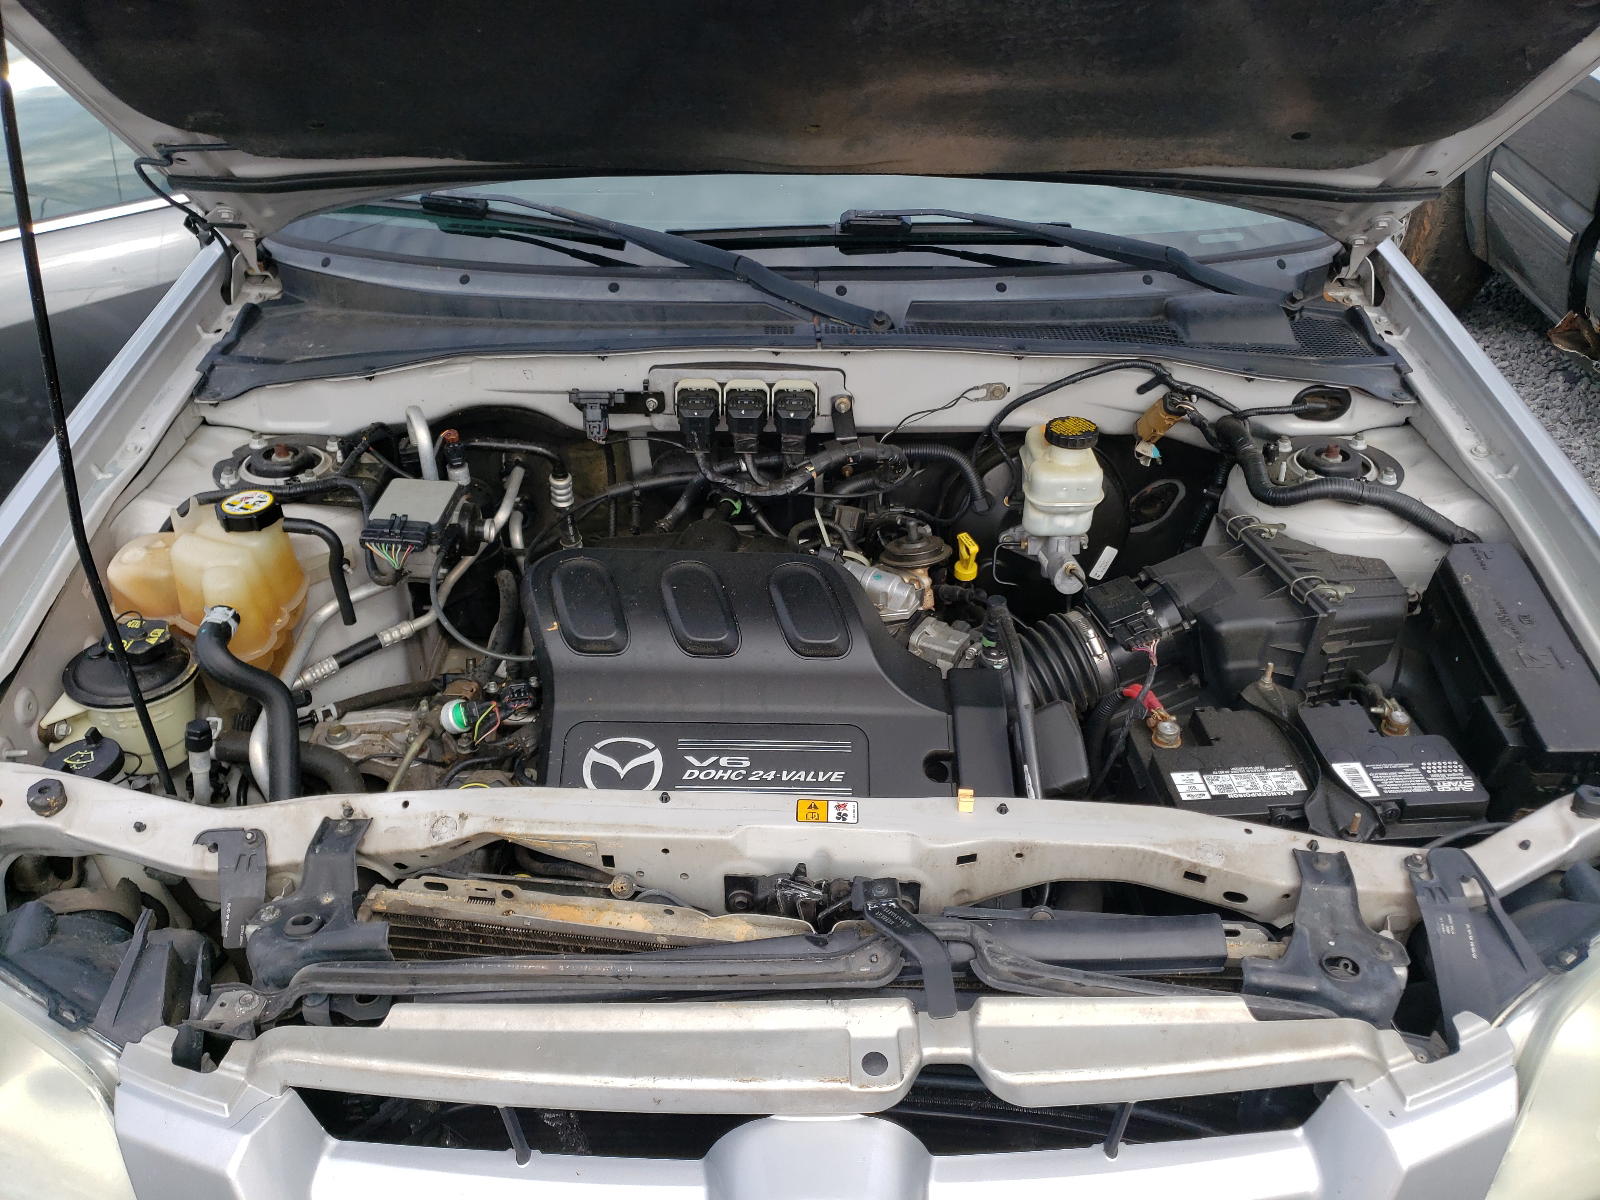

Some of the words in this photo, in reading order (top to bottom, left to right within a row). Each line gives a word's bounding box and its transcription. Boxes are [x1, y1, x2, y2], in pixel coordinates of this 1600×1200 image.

[683, 755, 751, 767] V6
[682, 769, 748, 781] DOHC
[748, 770, 845, 782] 24-VALVE
